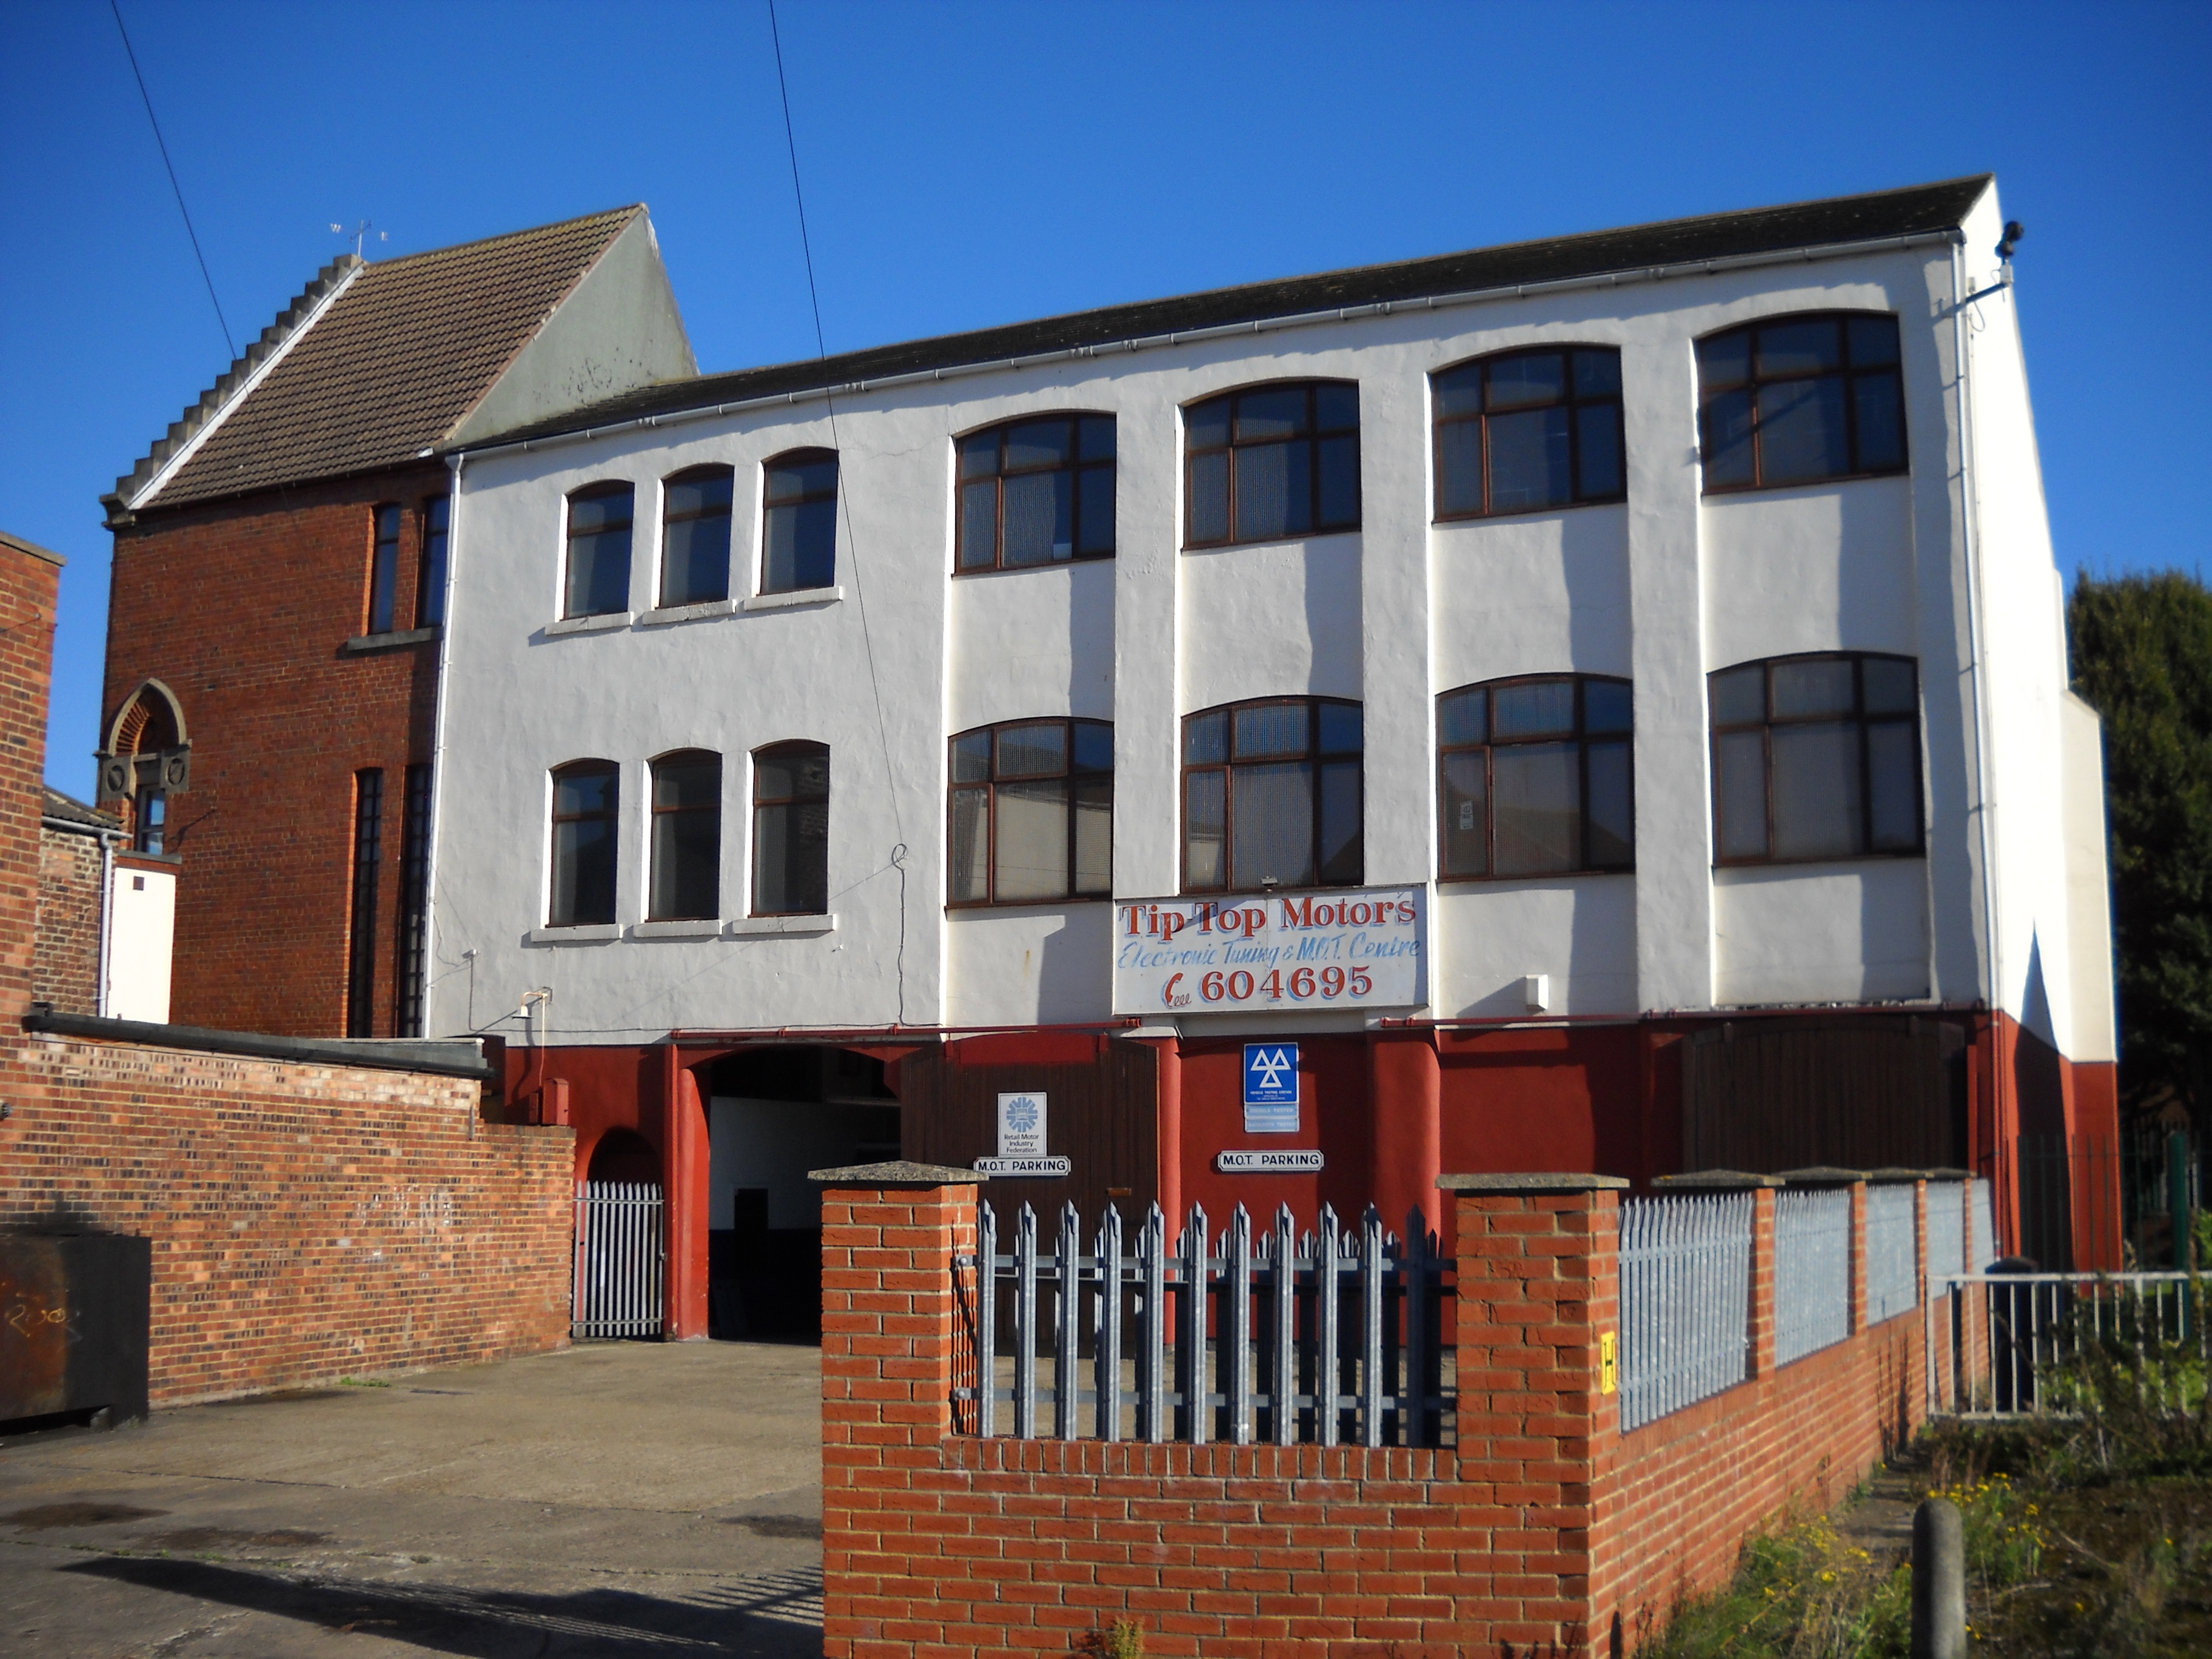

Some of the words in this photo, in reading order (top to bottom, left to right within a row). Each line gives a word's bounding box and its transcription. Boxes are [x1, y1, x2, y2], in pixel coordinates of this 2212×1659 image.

[1280, 897, 1416, 929] Motors
[1118, 941, 1218, 968] Electronic
[1222, 937, 1280, 969] Tuning
[1282, 945, 1293, 960] &
[1349, 931, 1420, 958] Centre
[1201, 965, 1372, 1001] 604695
[978, 1161, 1006, 1171] M.O.T.
[1012, 1161, 1065, 1170] PARKING
[1223, 1155, 1253, 1165] M.O.T.
[1262, 1155, 1319, 1165] PARKING
